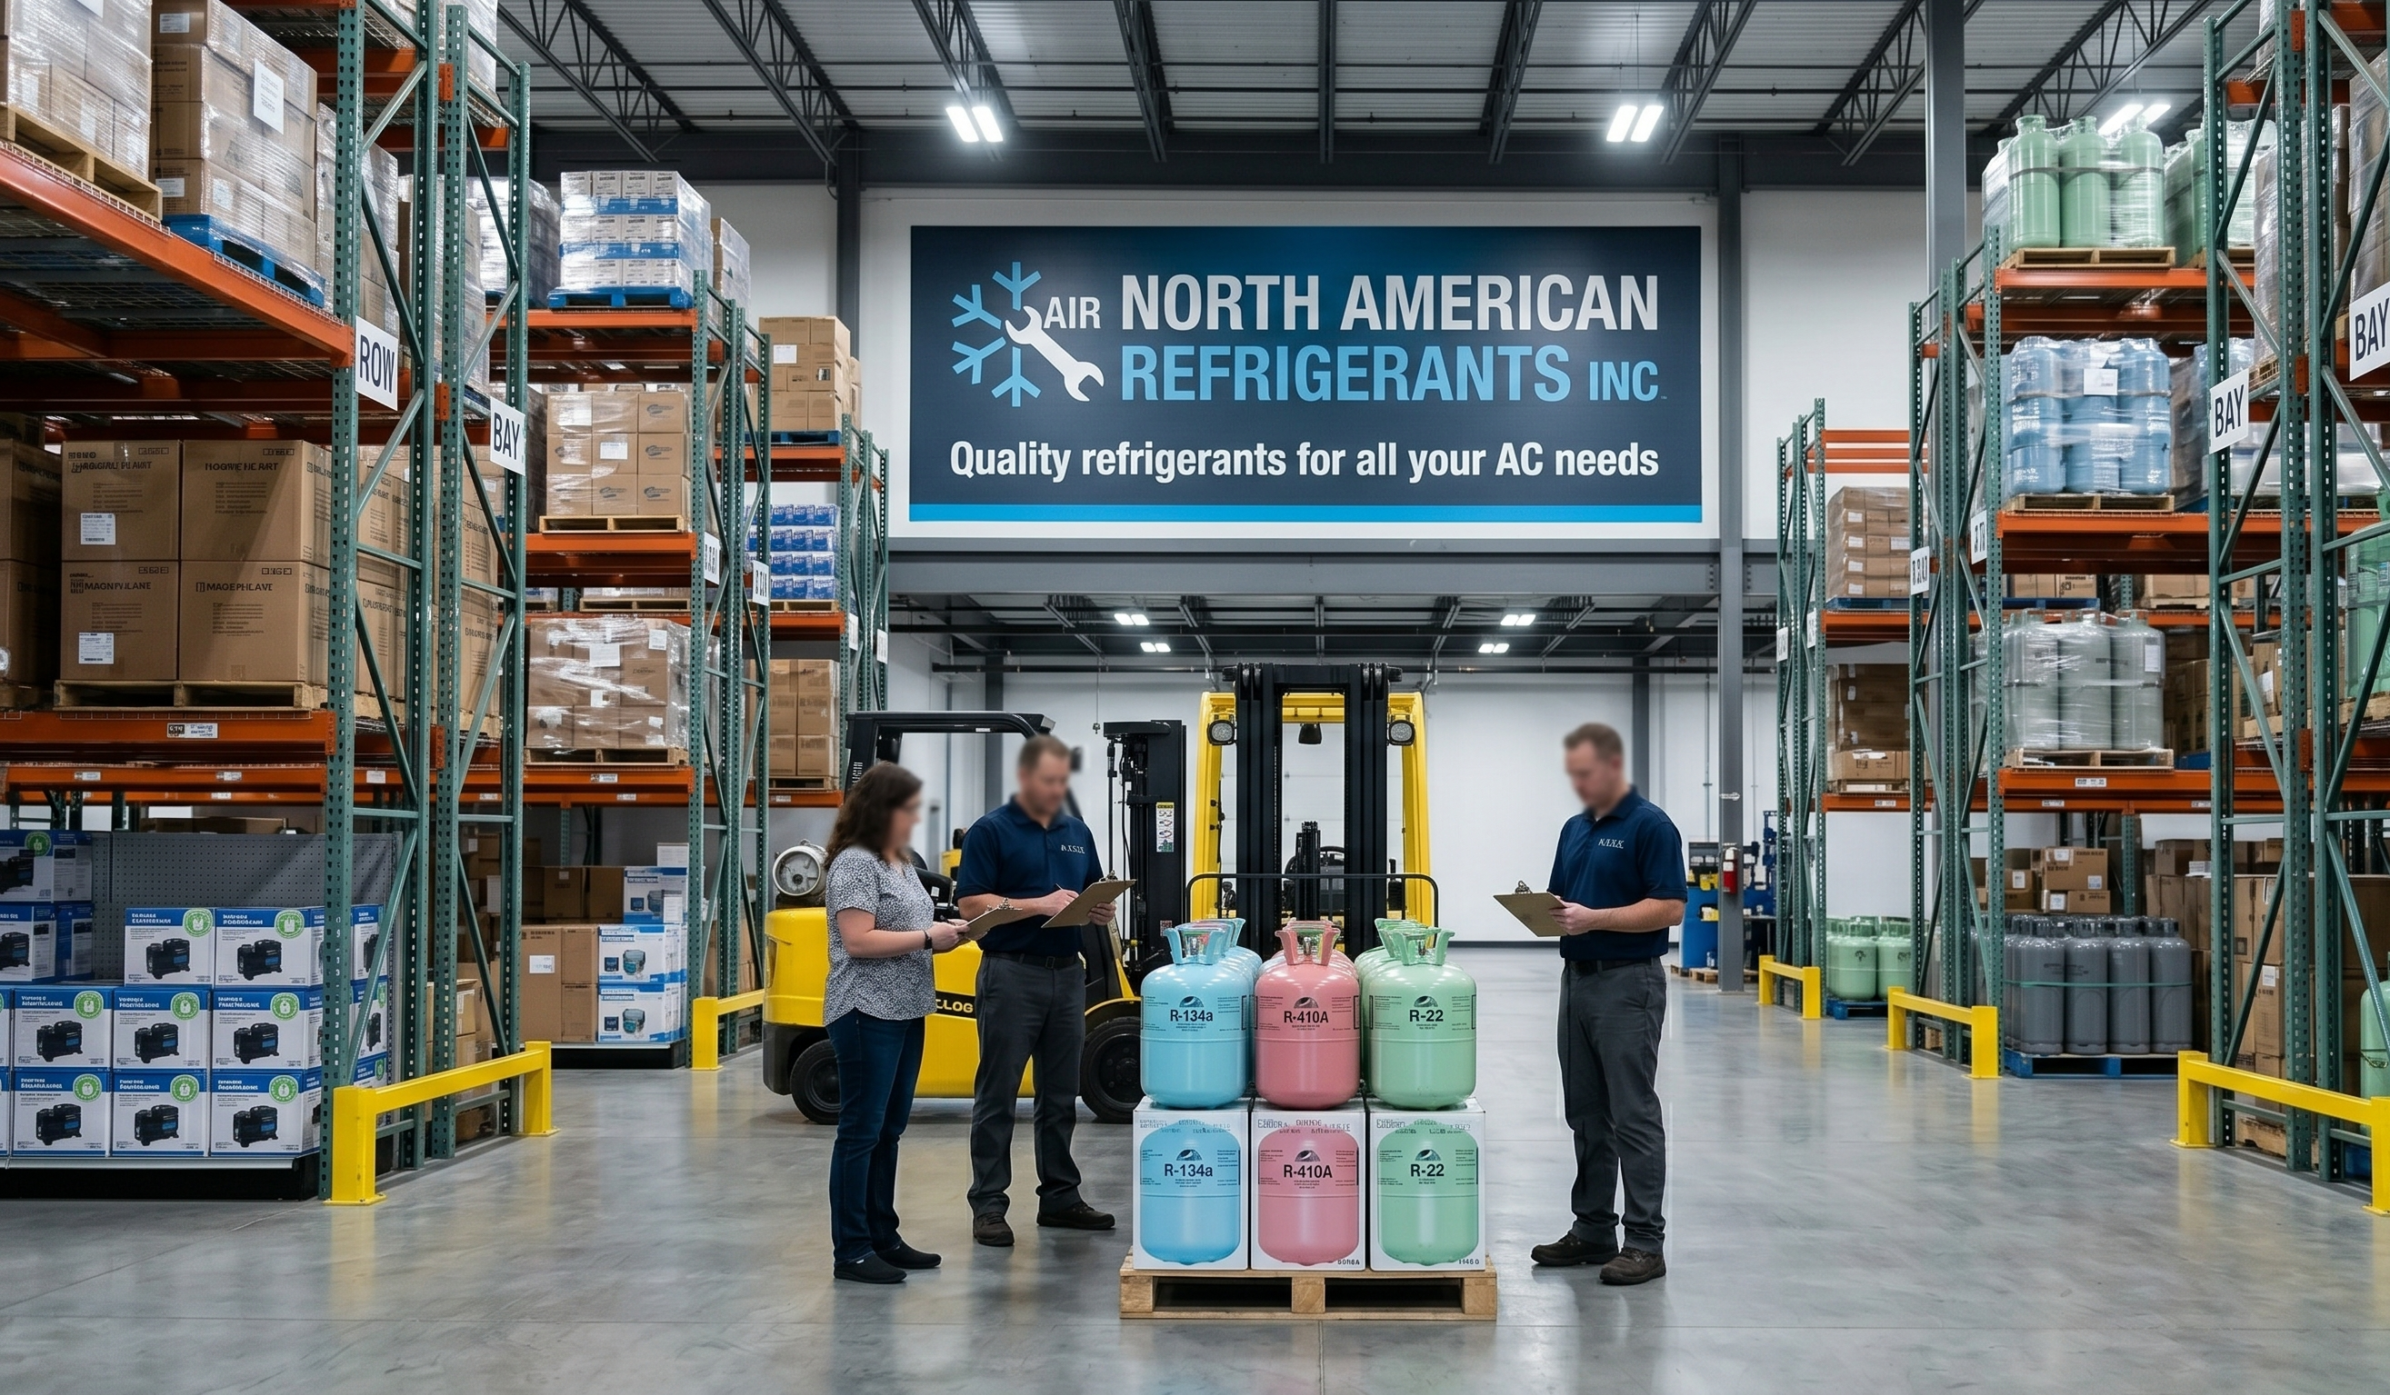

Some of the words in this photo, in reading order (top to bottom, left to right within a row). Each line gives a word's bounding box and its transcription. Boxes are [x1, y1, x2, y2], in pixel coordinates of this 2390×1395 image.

[1043, 296, 1101, 329] AIR
[1121, 274, 1319, 331] NORTH
[1339, 273, 1659, 332] AMERICAN
[2355, 298, 2390, 361] BAY
[359, 334, 395, 394] ROW
[1121, 344, 1572, 402] REFRIGERANTS
[1589, 360, 1659, 402] INC
[2214, 384, 2245, 438] BAY
[493, 412, 520, 460] BAY
[950, 440, 1072, 484] Quality
[1082, 440, 1287, 484] refrigerants
[1296, 441, 1347, 476] for
[1356, 441, 1397, 476] all
[1407, 449, 1487, 484] your
[1494, 441, 1544, 477] AC
[1555, 441, 1659, 476] needs
[1170, 1009, 1214, 1022] R-134a
[1409, 1009, 1444, 1022] R-22
[1164, 1163, 1213, 1177] R-134a
[1410, 1163, 1445, 1177] R-22
